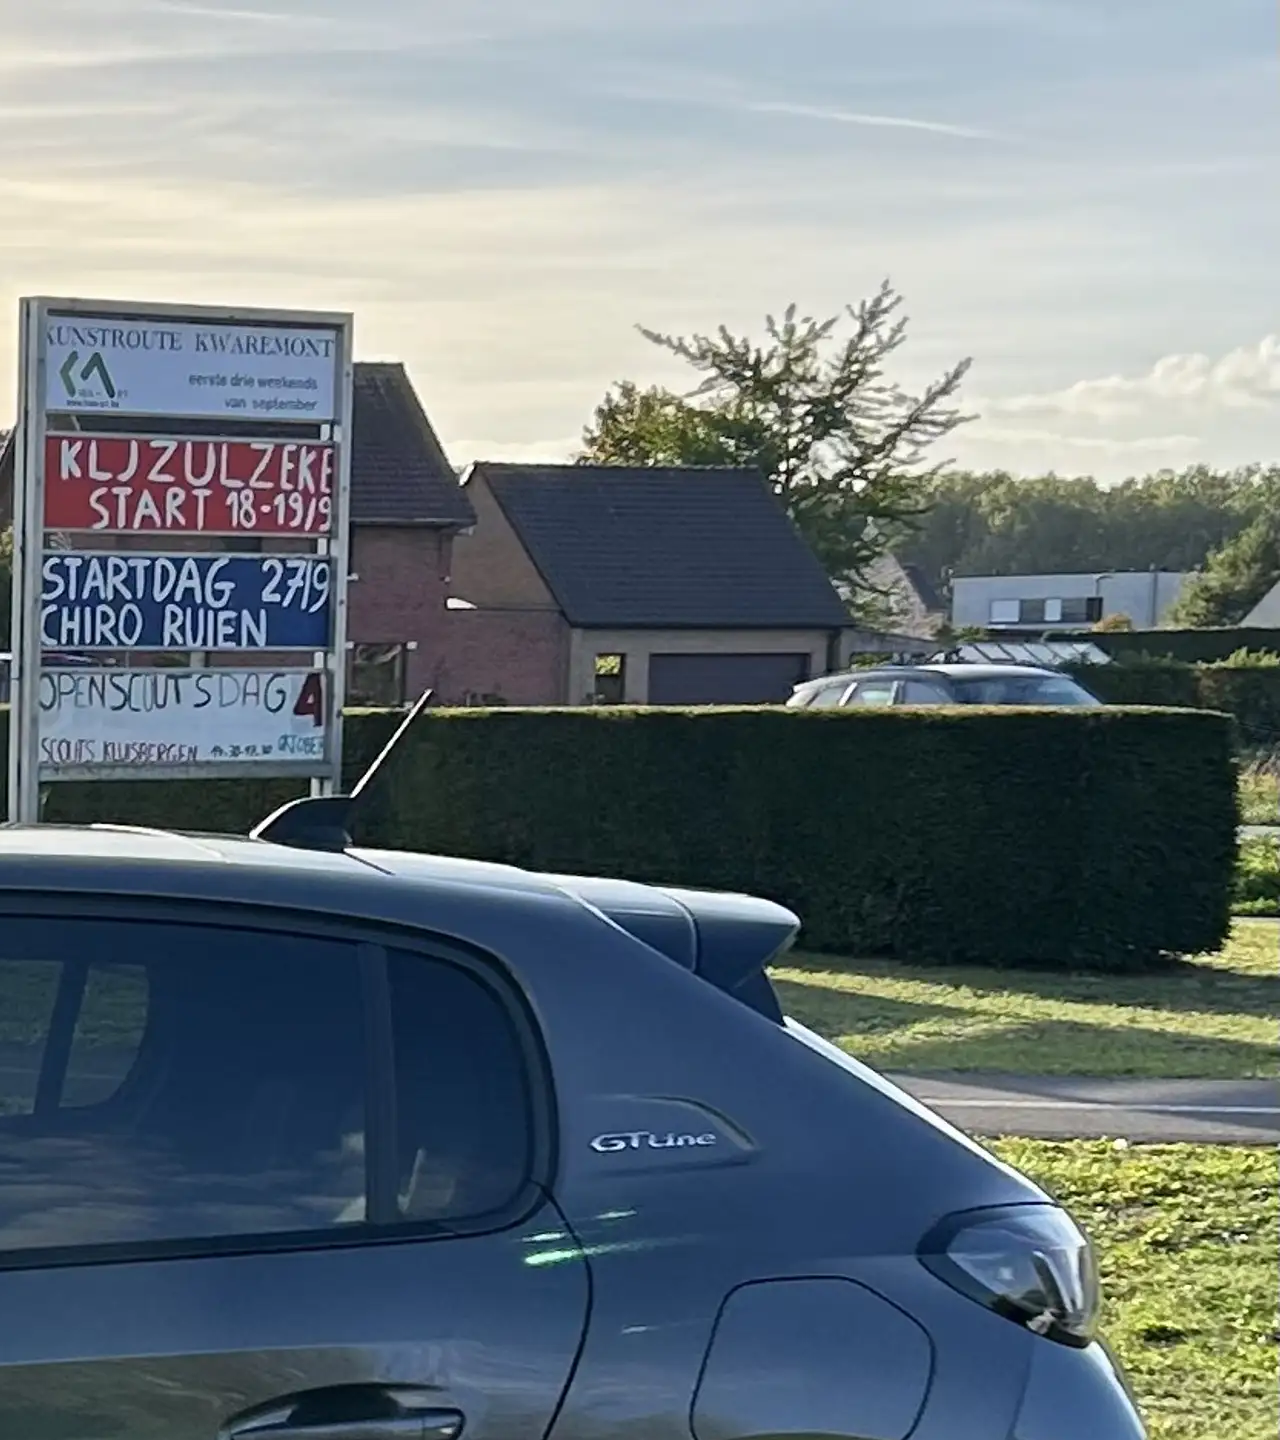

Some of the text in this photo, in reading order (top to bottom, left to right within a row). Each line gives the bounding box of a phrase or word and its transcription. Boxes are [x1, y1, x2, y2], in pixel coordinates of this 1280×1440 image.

[195, 335, 335, 358] KWAREMONT
[230, 372, 255, 388] drie
[224, 398, 247, 408] van
[89, 486, 213, 531] START
[41, 557, 329, 613] STARTDAG 27/9
[40, 603, 267, 648] CHIRO RUIEN
